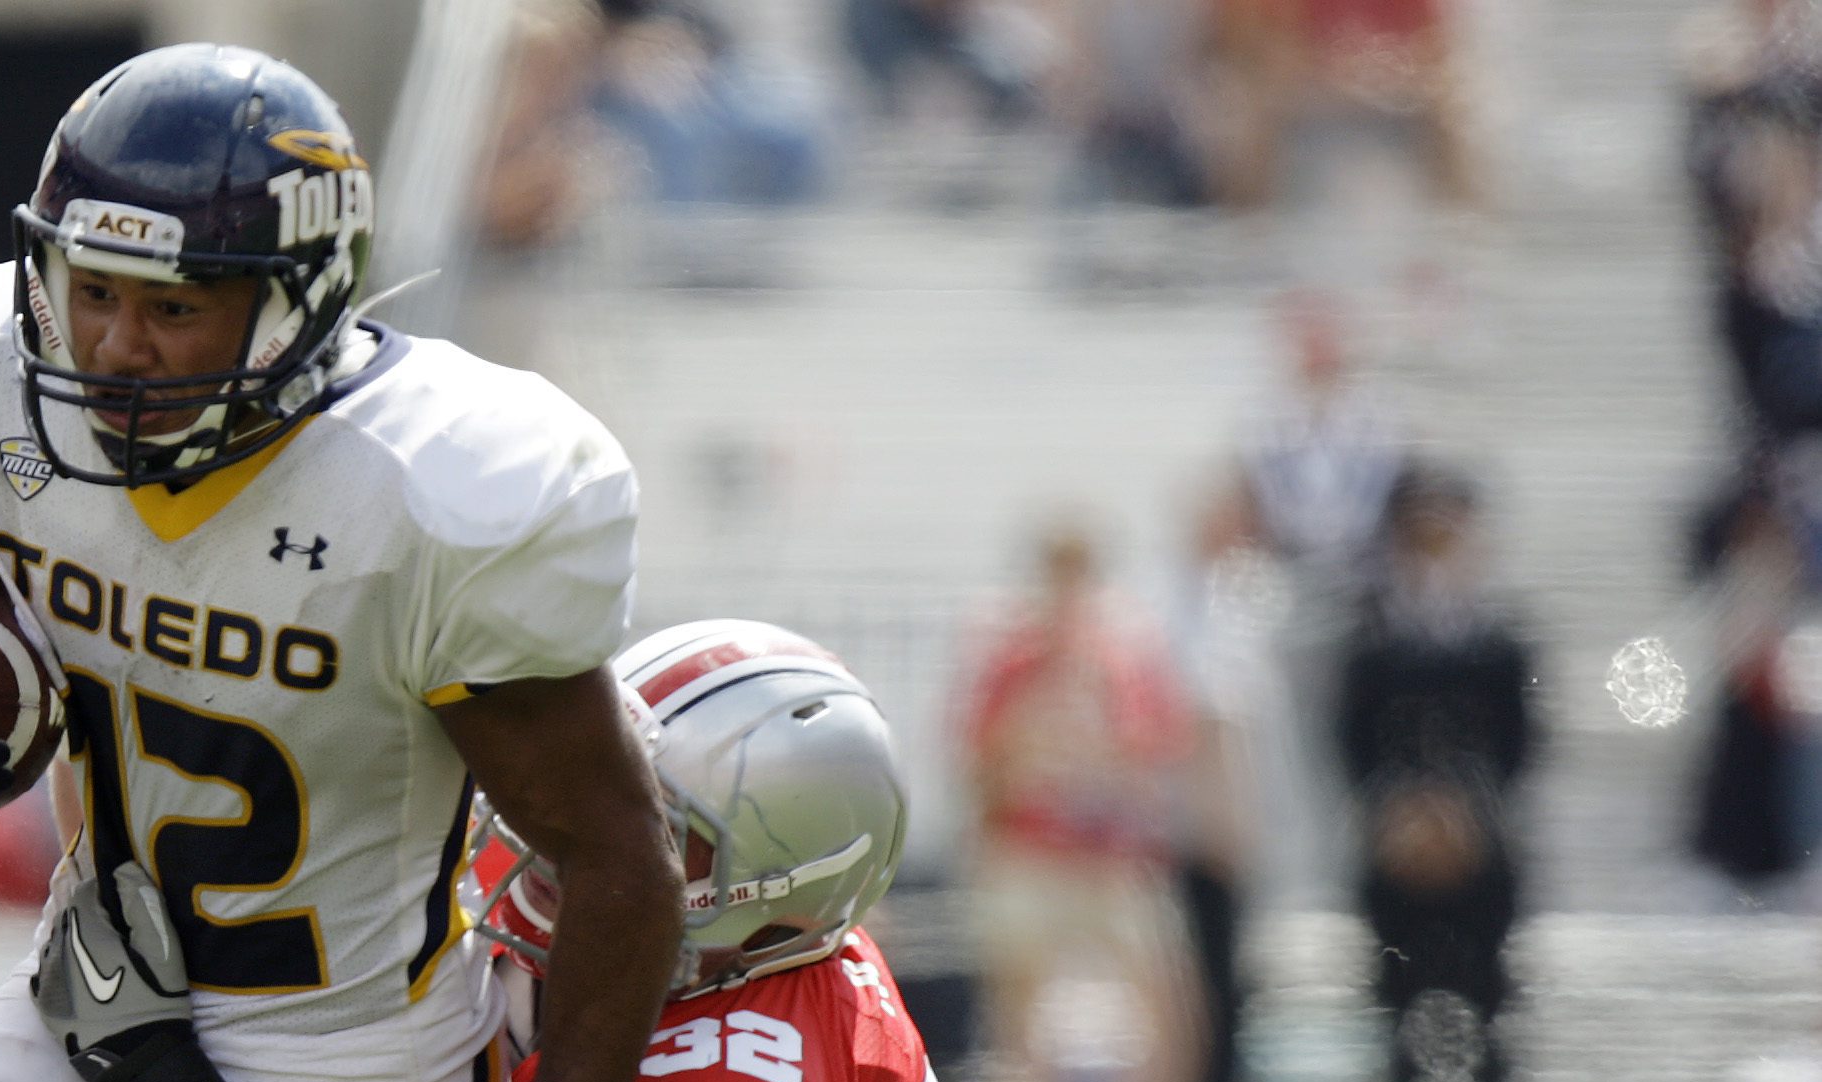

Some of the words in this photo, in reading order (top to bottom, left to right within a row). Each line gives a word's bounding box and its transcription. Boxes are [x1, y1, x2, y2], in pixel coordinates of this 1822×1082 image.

[95, 211, 154, 240] ACT
[27, 276, 62, 350] Riddell
[1, 452, 54, 480] MAC
[61, 662, 330, 996] 12
